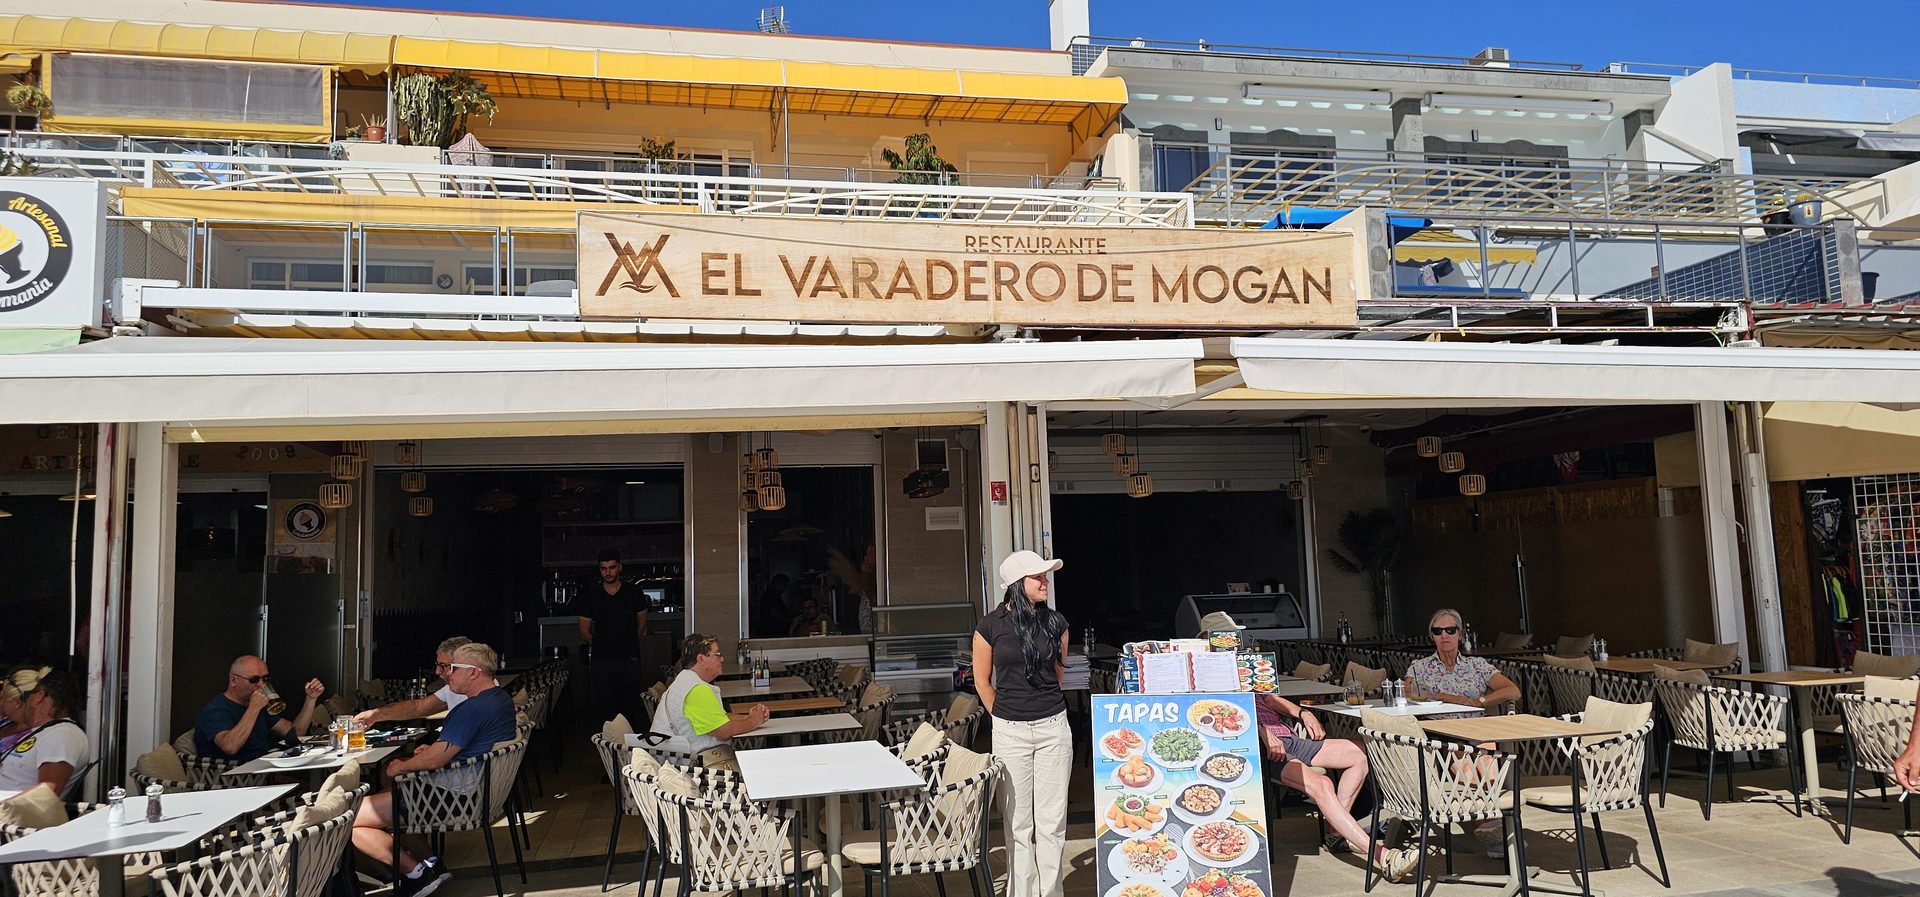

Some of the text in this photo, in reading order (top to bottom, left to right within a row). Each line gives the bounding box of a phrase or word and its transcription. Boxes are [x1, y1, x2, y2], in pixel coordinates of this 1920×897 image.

[8, 196, 68, 248] Artesanal
[965, 235, 1107, 255] RESTAURANTE
[701, 252, 1333, 306] EL VARADERO DE MOGAN
[0, 277, 54, 308] mania
[236, 444, 296, 461] 2009
[1103, 702, 1180, 724] TAPAS
